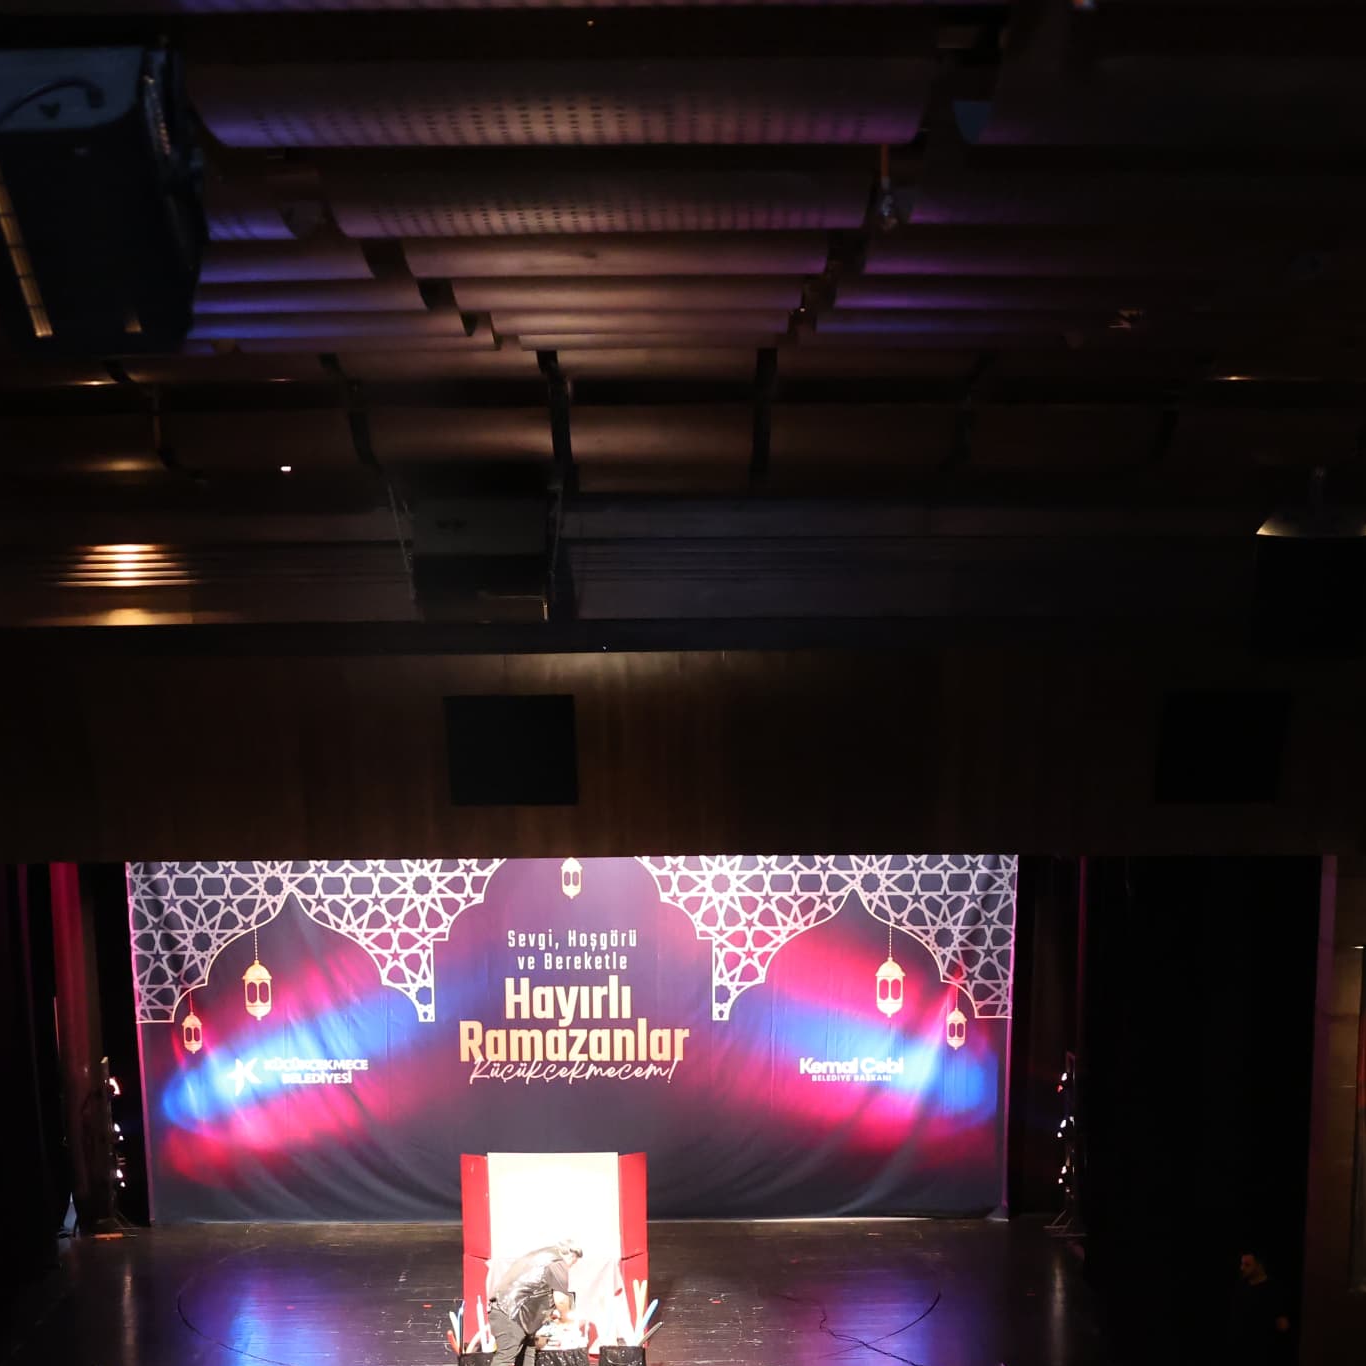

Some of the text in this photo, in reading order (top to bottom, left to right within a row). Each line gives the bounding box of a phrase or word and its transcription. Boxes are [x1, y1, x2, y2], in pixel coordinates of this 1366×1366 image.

[507, 929, 637, 952] Sevgi, Hoşgörü
[517, 952, 628, 970] ve Bereketle
[504, 974, 632, 1027] Hayırlı
[459, 1018, 689, 1062] Ramazanlar
[799, 1057, 859, 1074] Kemal
[281, 1069, 352, 1084] BELEDİYESİ
